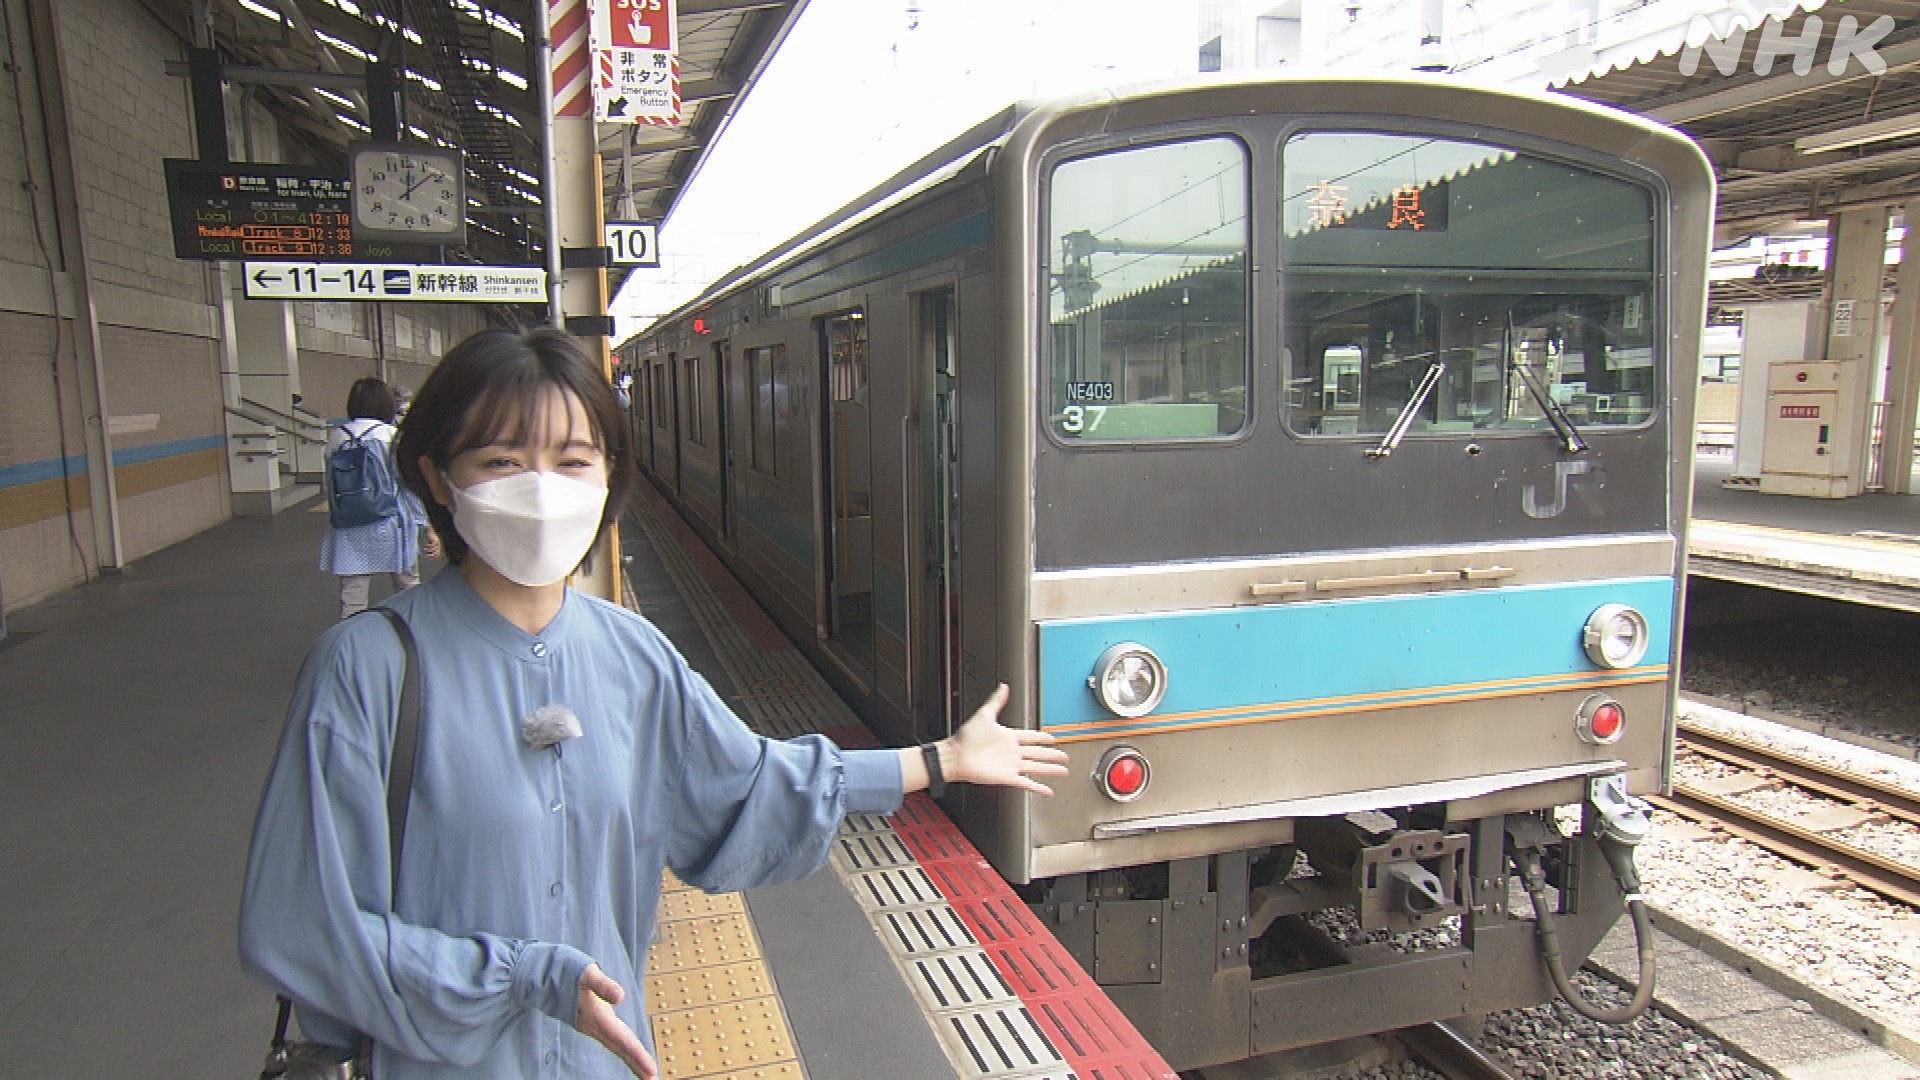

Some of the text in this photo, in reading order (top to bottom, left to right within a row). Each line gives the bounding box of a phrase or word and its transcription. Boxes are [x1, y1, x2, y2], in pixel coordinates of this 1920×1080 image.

[620, 52, 667, 69] 非常
[621, 68, 667, 84] ボタン
[621, 86, 668, 97] Emergency
[640, 96, 669, 107] Button
[1306, 180, 1425, 231] 奈良
[196, 209, 231, 222] Local
[200, 240, 235, 252] Local
[611, 229, 647, 258] 10
[417, 273, 478, 293] 新幹線
[483, 275, 539, 285] Shinkansen
[1067, 383, 1112, 399] NE403
[1063, 405, 1107, 431] 37
